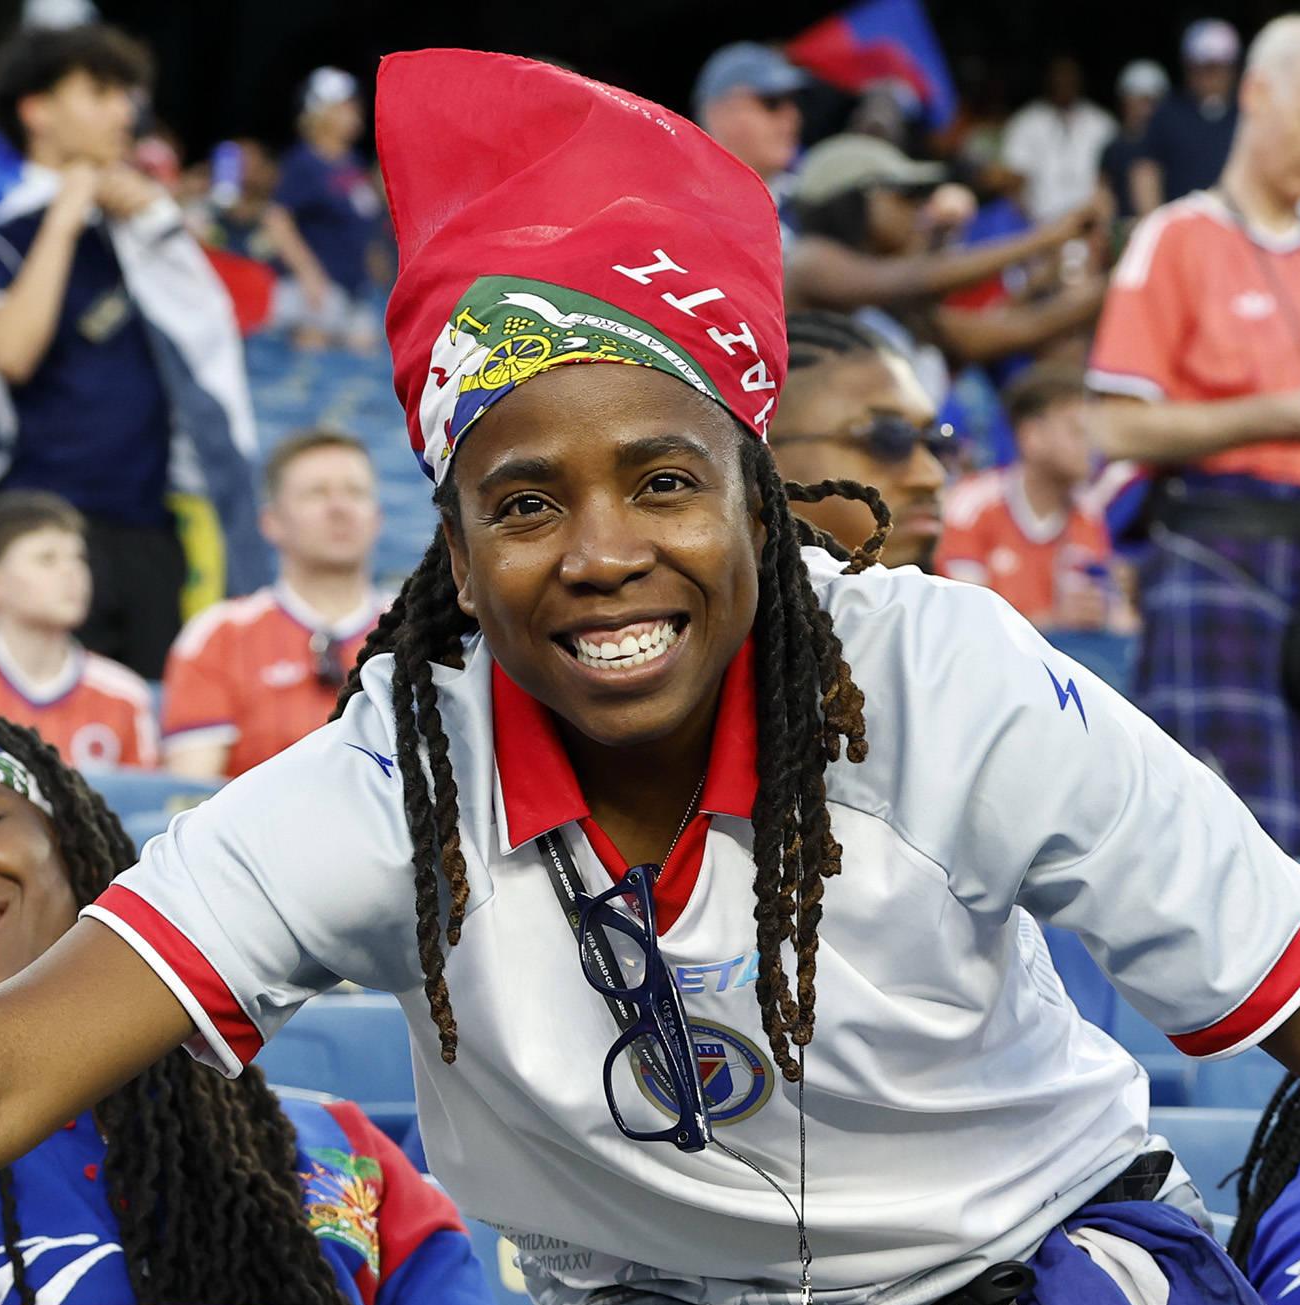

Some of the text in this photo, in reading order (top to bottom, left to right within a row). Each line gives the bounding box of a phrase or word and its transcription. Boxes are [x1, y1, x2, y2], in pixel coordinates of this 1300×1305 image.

[575, 313, 645, 340] FORCE
[553, 857, 564, 873] CUP
[559, 872, 576, 900] 2026
[585, 931, 596, 949] FIFA
[593, 948, 610, 976] WORLD
[605, 975, 616, 988] CU
[676, 949, 760, 993] ETA
[697, 1045, 719, 1054] ITI
